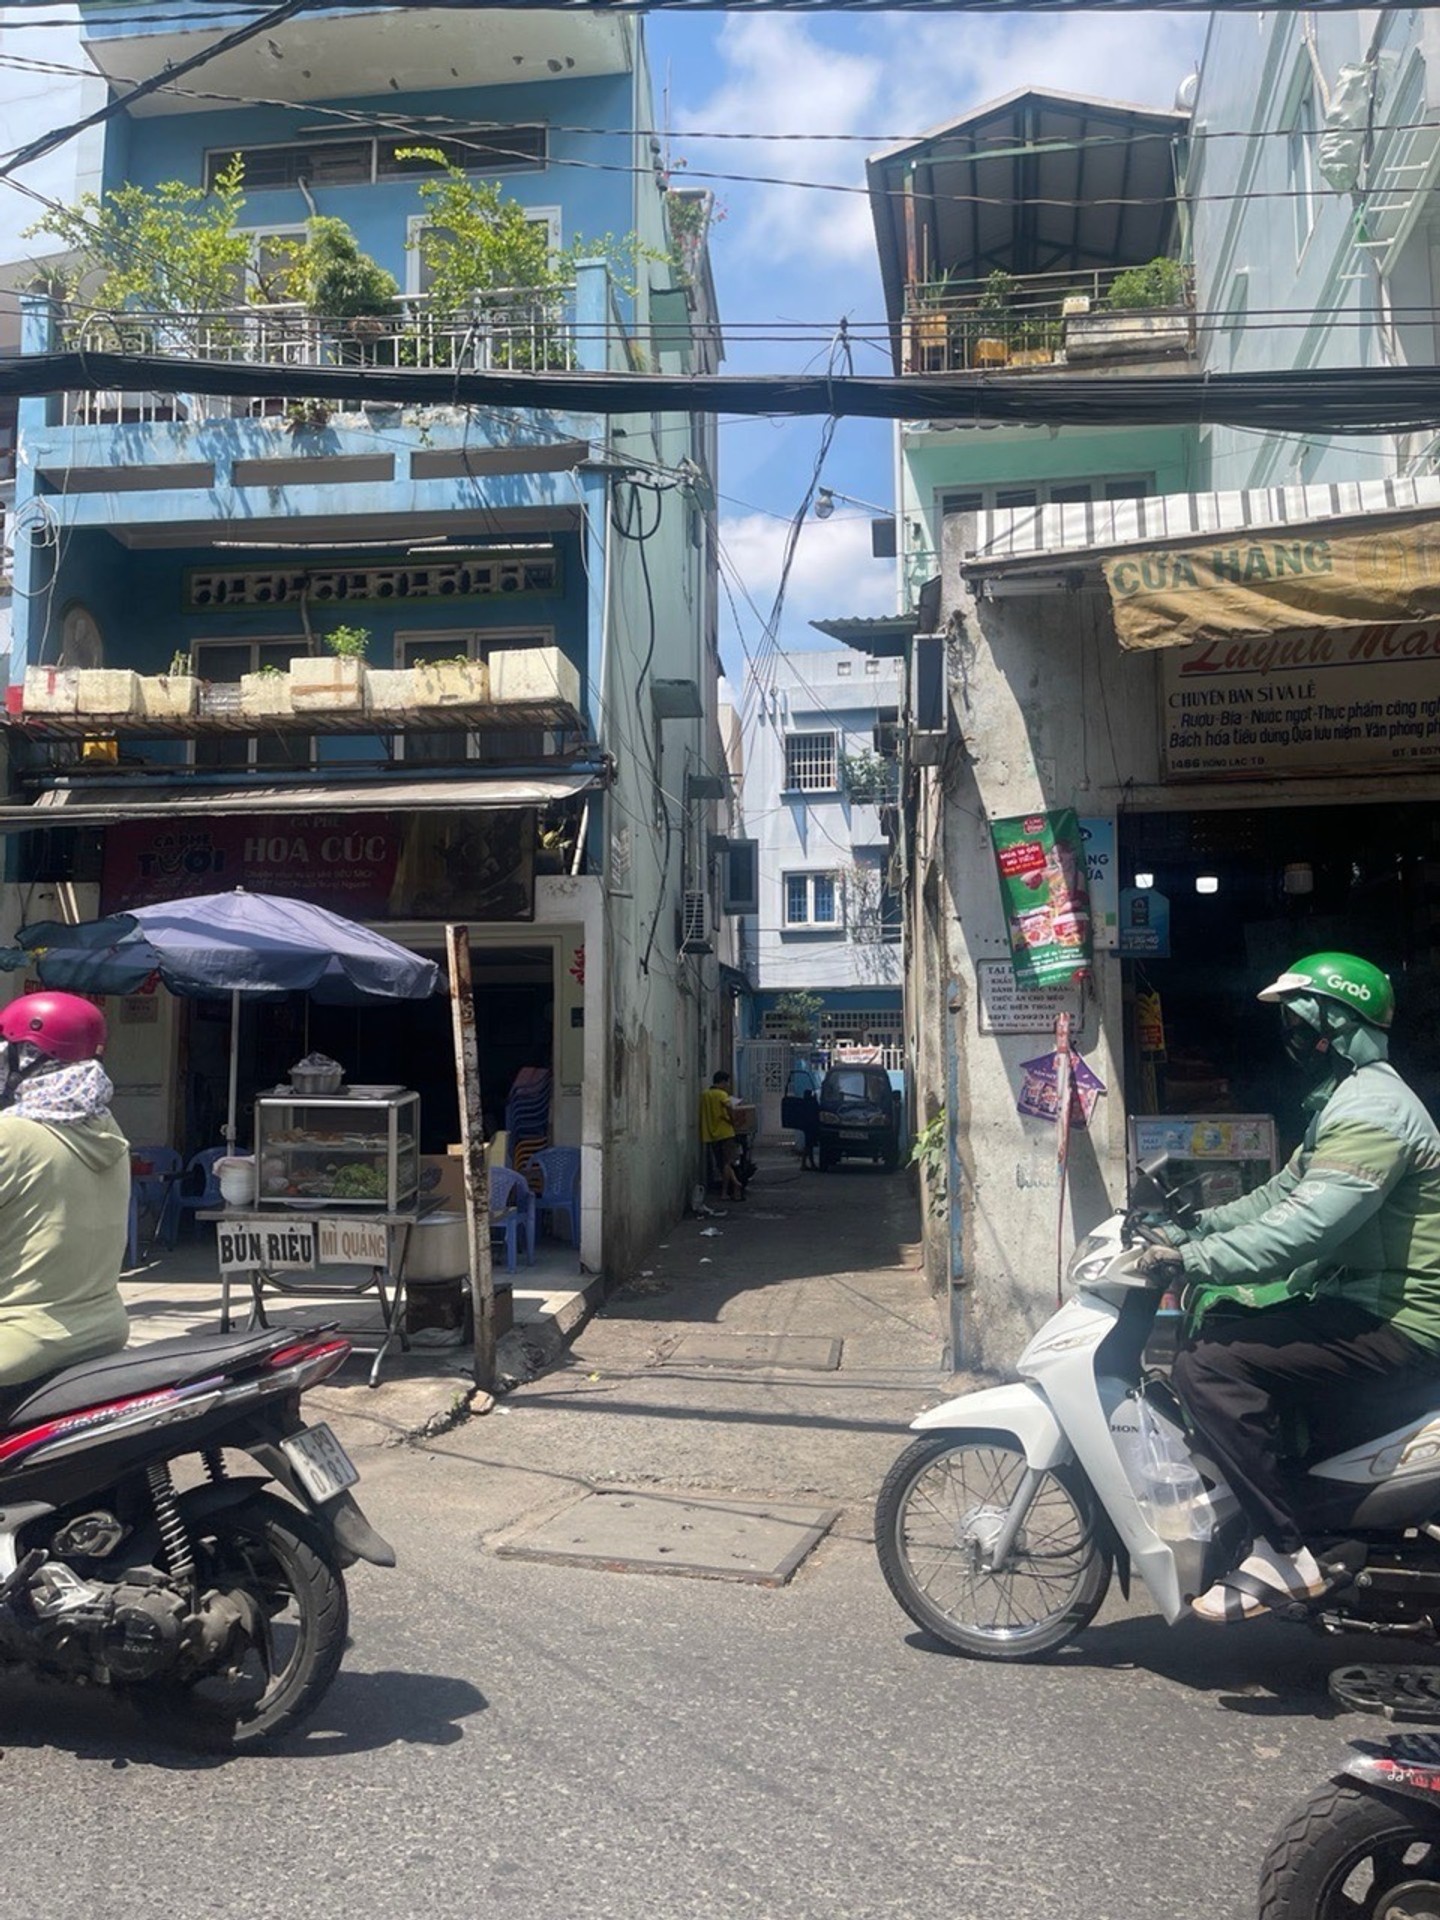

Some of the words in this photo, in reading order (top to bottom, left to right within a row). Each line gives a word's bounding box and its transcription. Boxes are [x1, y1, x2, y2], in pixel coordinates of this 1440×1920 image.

[243, 836, 309, 862] HOA
[321, 830, 386, 862] CÚC
[1326, 973, 1371, 1001] Grab
[220, 1225, 261, 1264] BÚN
[268, 1226, 311, 1262] RIÊU
[321, 1223, 338, 1255] MÌ
[342, 1223, 385, 1259] QUẢNG
